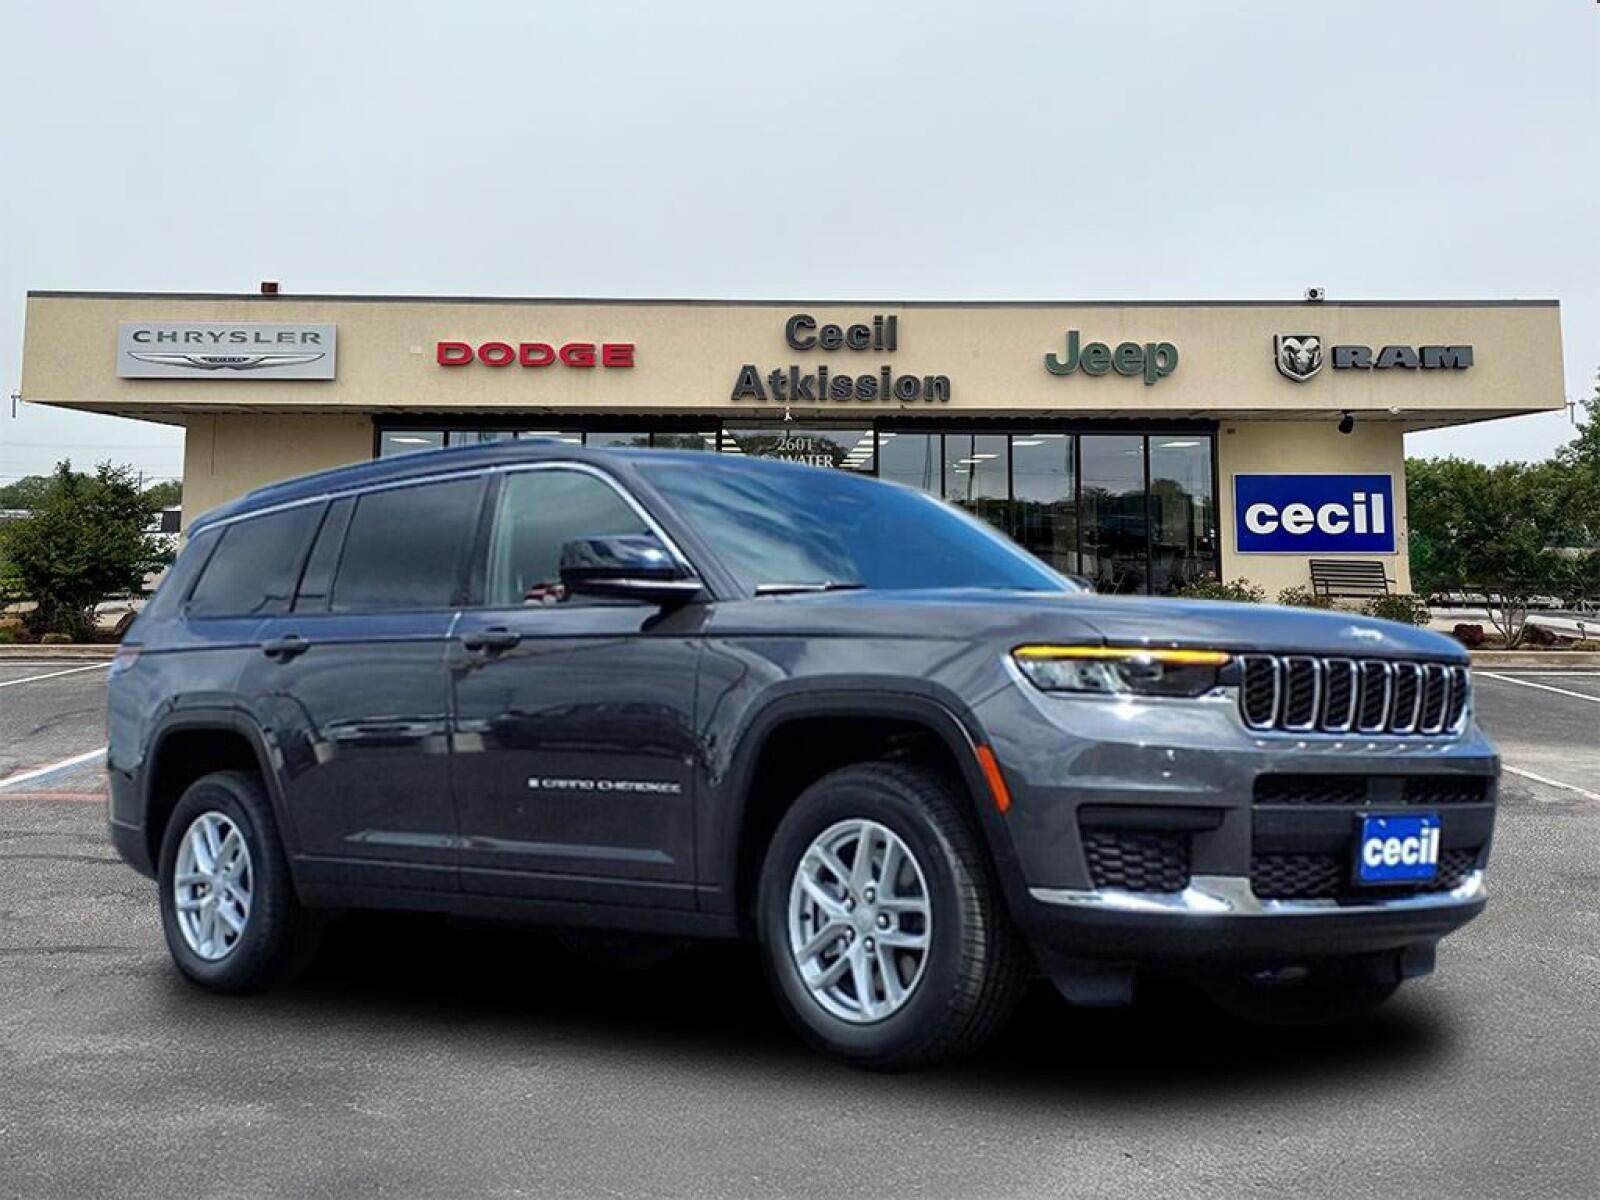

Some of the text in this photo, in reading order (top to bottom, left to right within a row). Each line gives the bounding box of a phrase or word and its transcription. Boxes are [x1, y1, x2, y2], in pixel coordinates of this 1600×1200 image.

[132, 330, 321, 344] CHRYSLER
[785, 313, 898, 351] Cecil
[436, 341, 635, 368] DODGE
[1045, 330, 1179, 386] Jeep
[1331, 345, 1474, 370] RAM
[731, 365, 951, 402] Atkission
[777, 437, 812, 451] 2601
[780, 454, 834, 468] WATER
[1245, 491, 1385, 534] cecil
[1363, 827, 1441, 867] cecil
